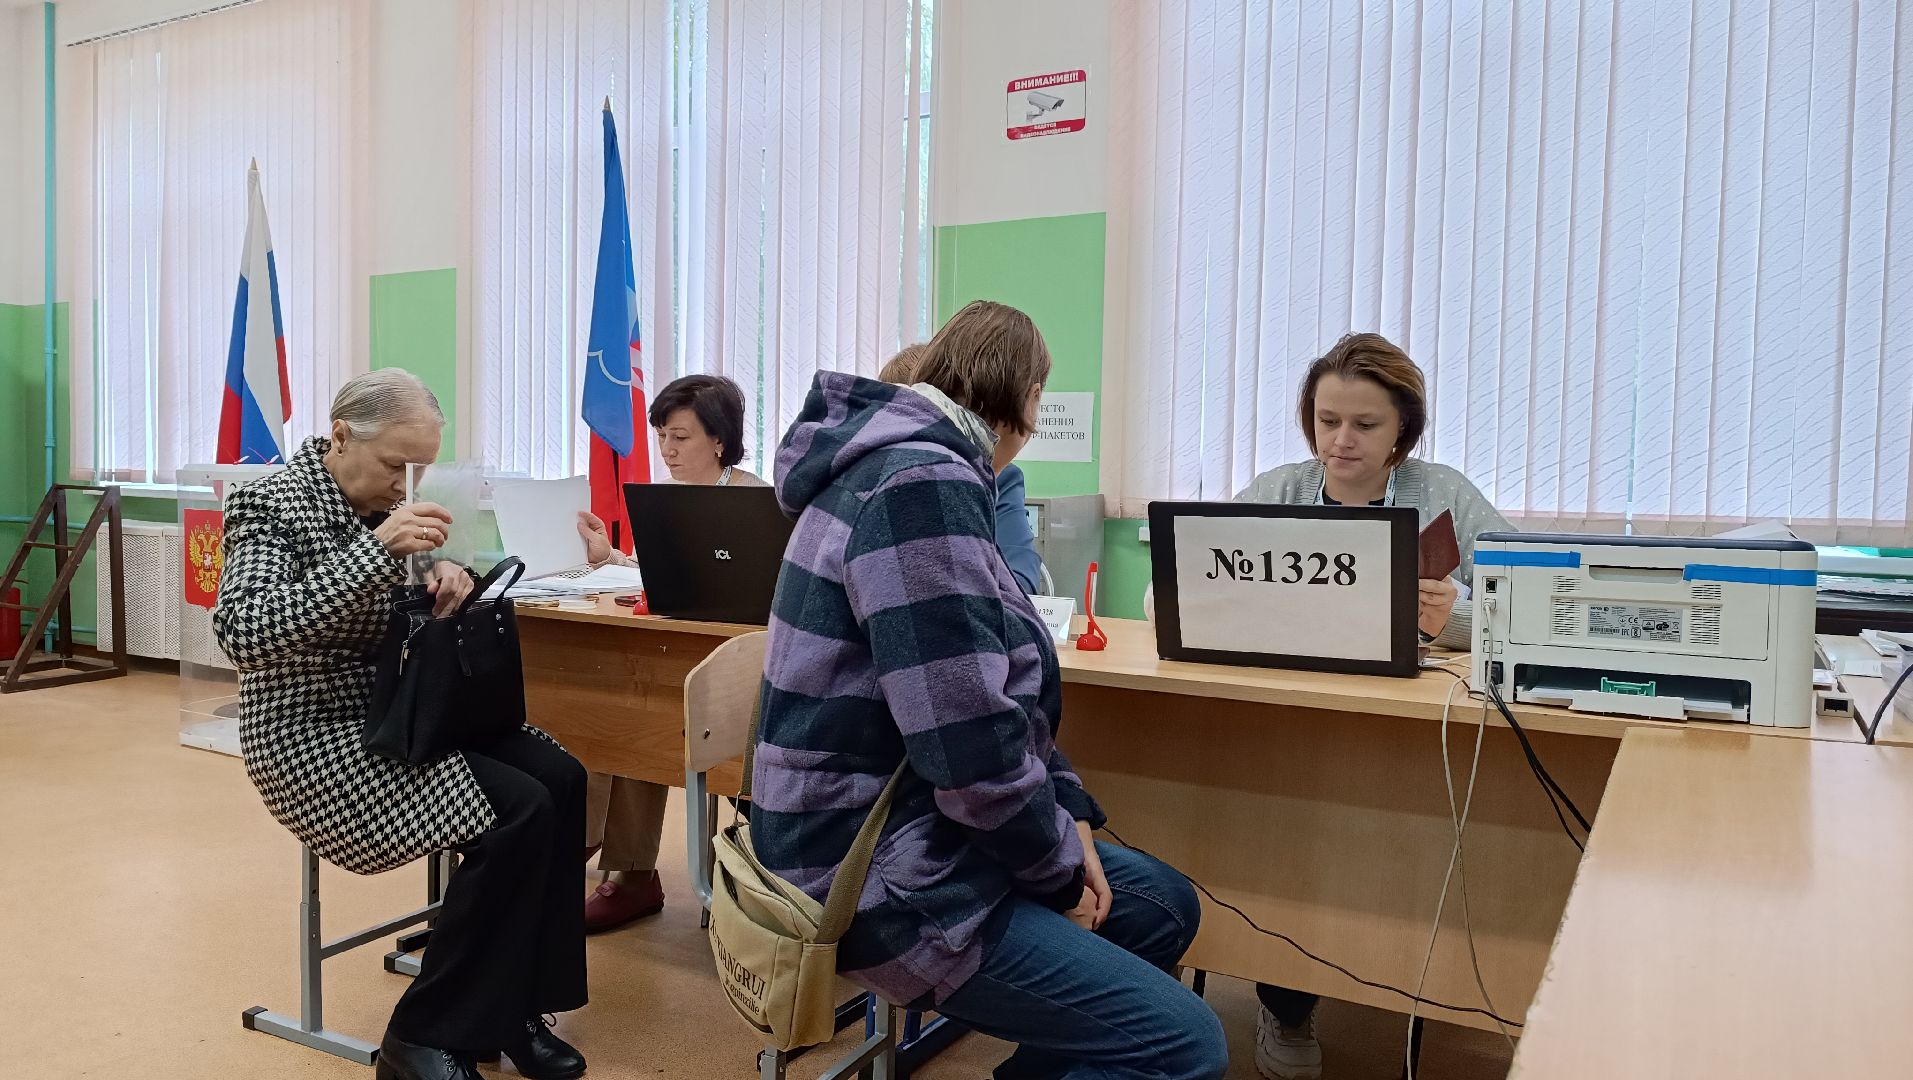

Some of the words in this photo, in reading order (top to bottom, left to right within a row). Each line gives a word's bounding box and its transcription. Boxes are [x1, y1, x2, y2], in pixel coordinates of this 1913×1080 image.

[1014, 72, 1079, 91] ВНИМАНИЕ!!!
[1040, 404, 1066, 413] ЕСТО
[1206, 547, 1357, 586] №1328
